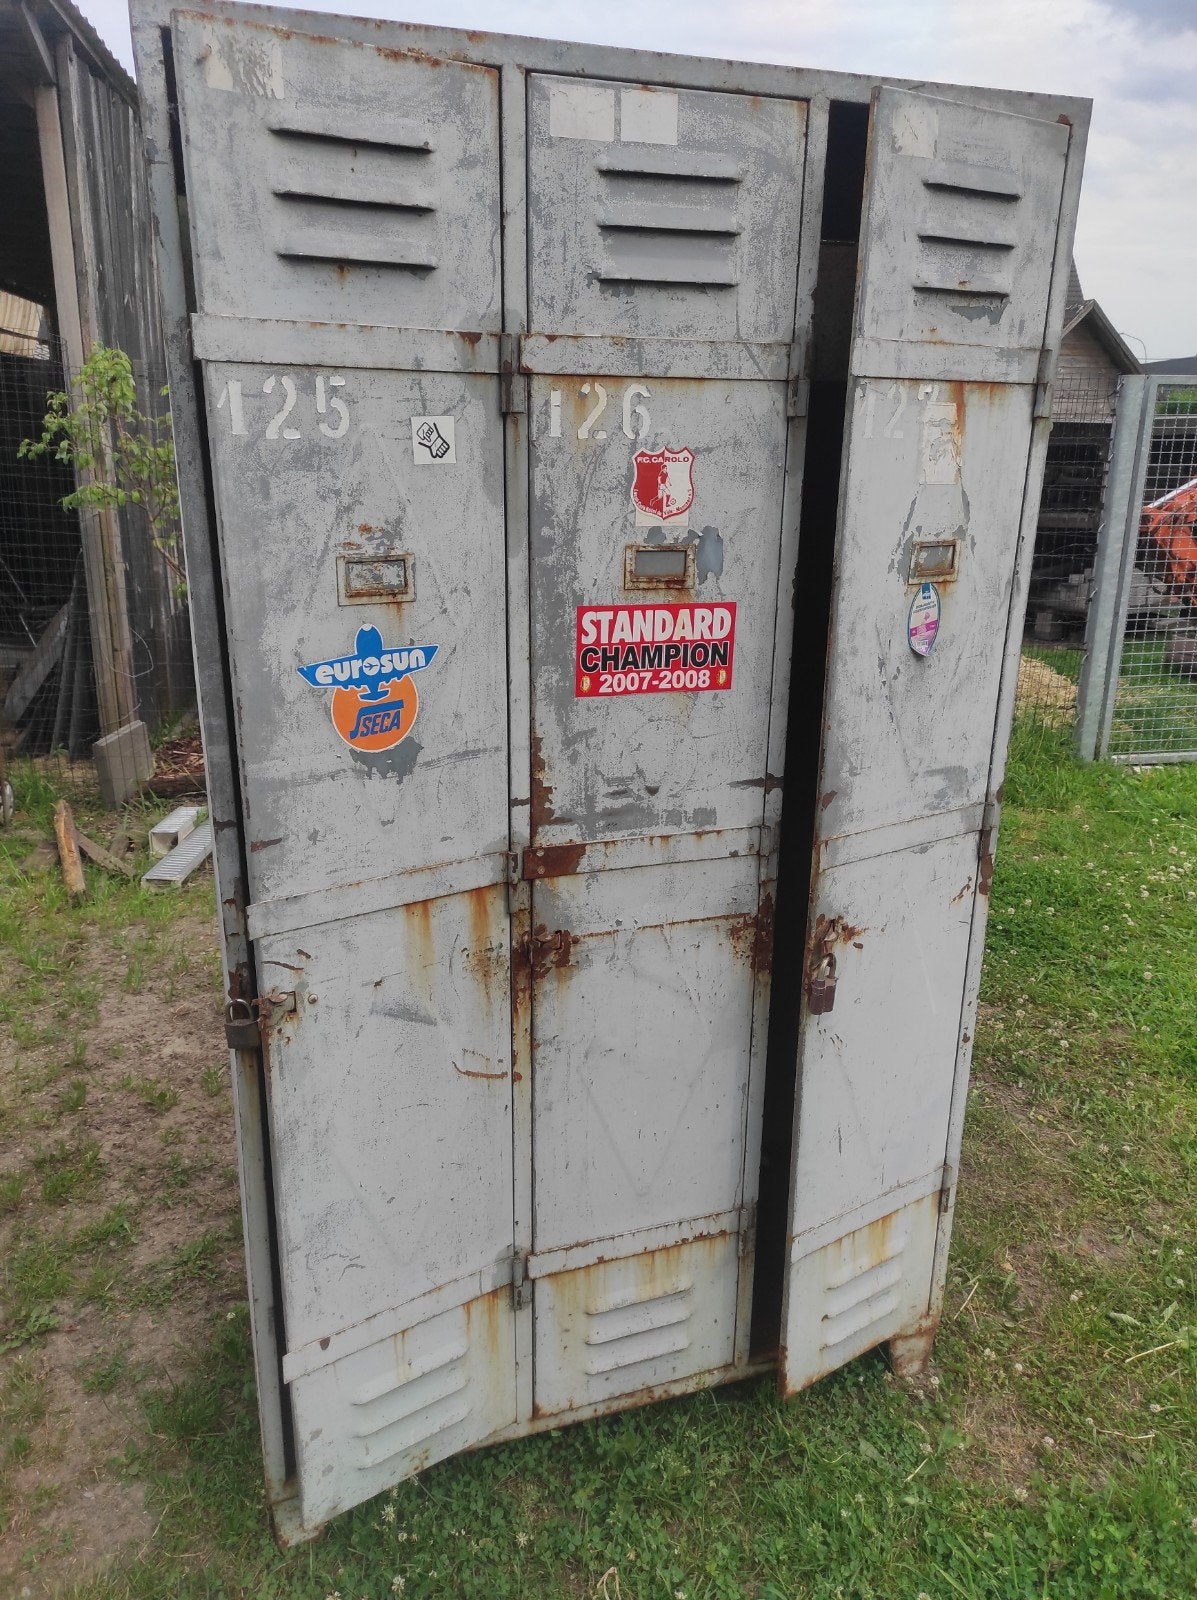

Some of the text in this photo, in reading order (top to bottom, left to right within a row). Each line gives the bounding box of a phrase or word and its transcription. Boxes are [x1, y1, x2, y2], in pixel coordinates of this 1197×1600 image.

[217, 375, 350, 439] 125
[549, 383, 652, 440] 126
[581, 607, 732, 645] STANDARD
[315, 648, 426, 685] eurosun
[580, 641, 730, 674] CHAMPION
[598, 669, 711, 694] 2007-2008
